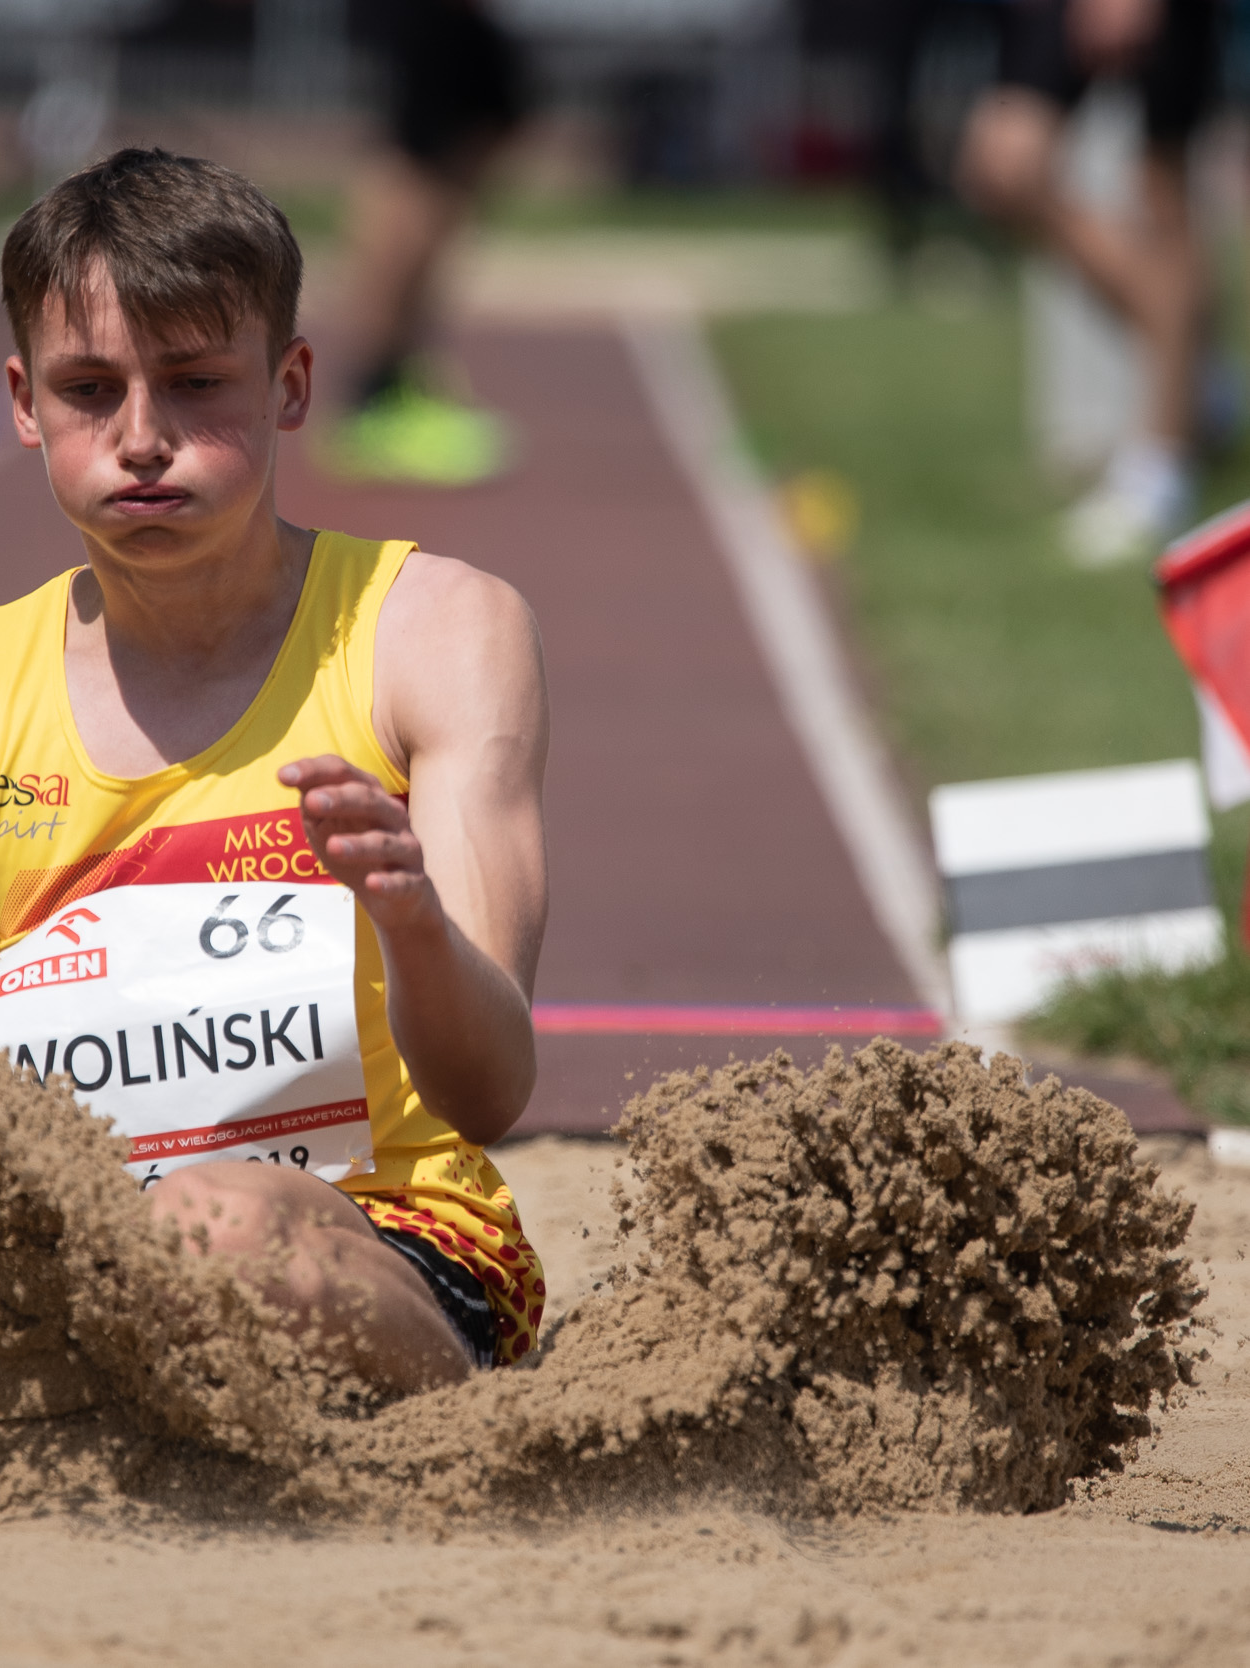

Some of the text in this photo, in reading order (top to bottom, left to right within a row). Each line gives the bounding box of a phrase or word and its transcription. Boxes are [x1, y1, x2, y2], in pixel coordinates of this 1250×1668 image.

[224, 819, 294, 853] MKS
[199, 894, 305, 959] 66
[1, 951, 101, 993] ORLEN
[162, 1139, 175, 1150] W
[177, 1121, 272, 1148] WIELOBOJACH
[281, 1105, 363, 1129] SZTAFETACH
